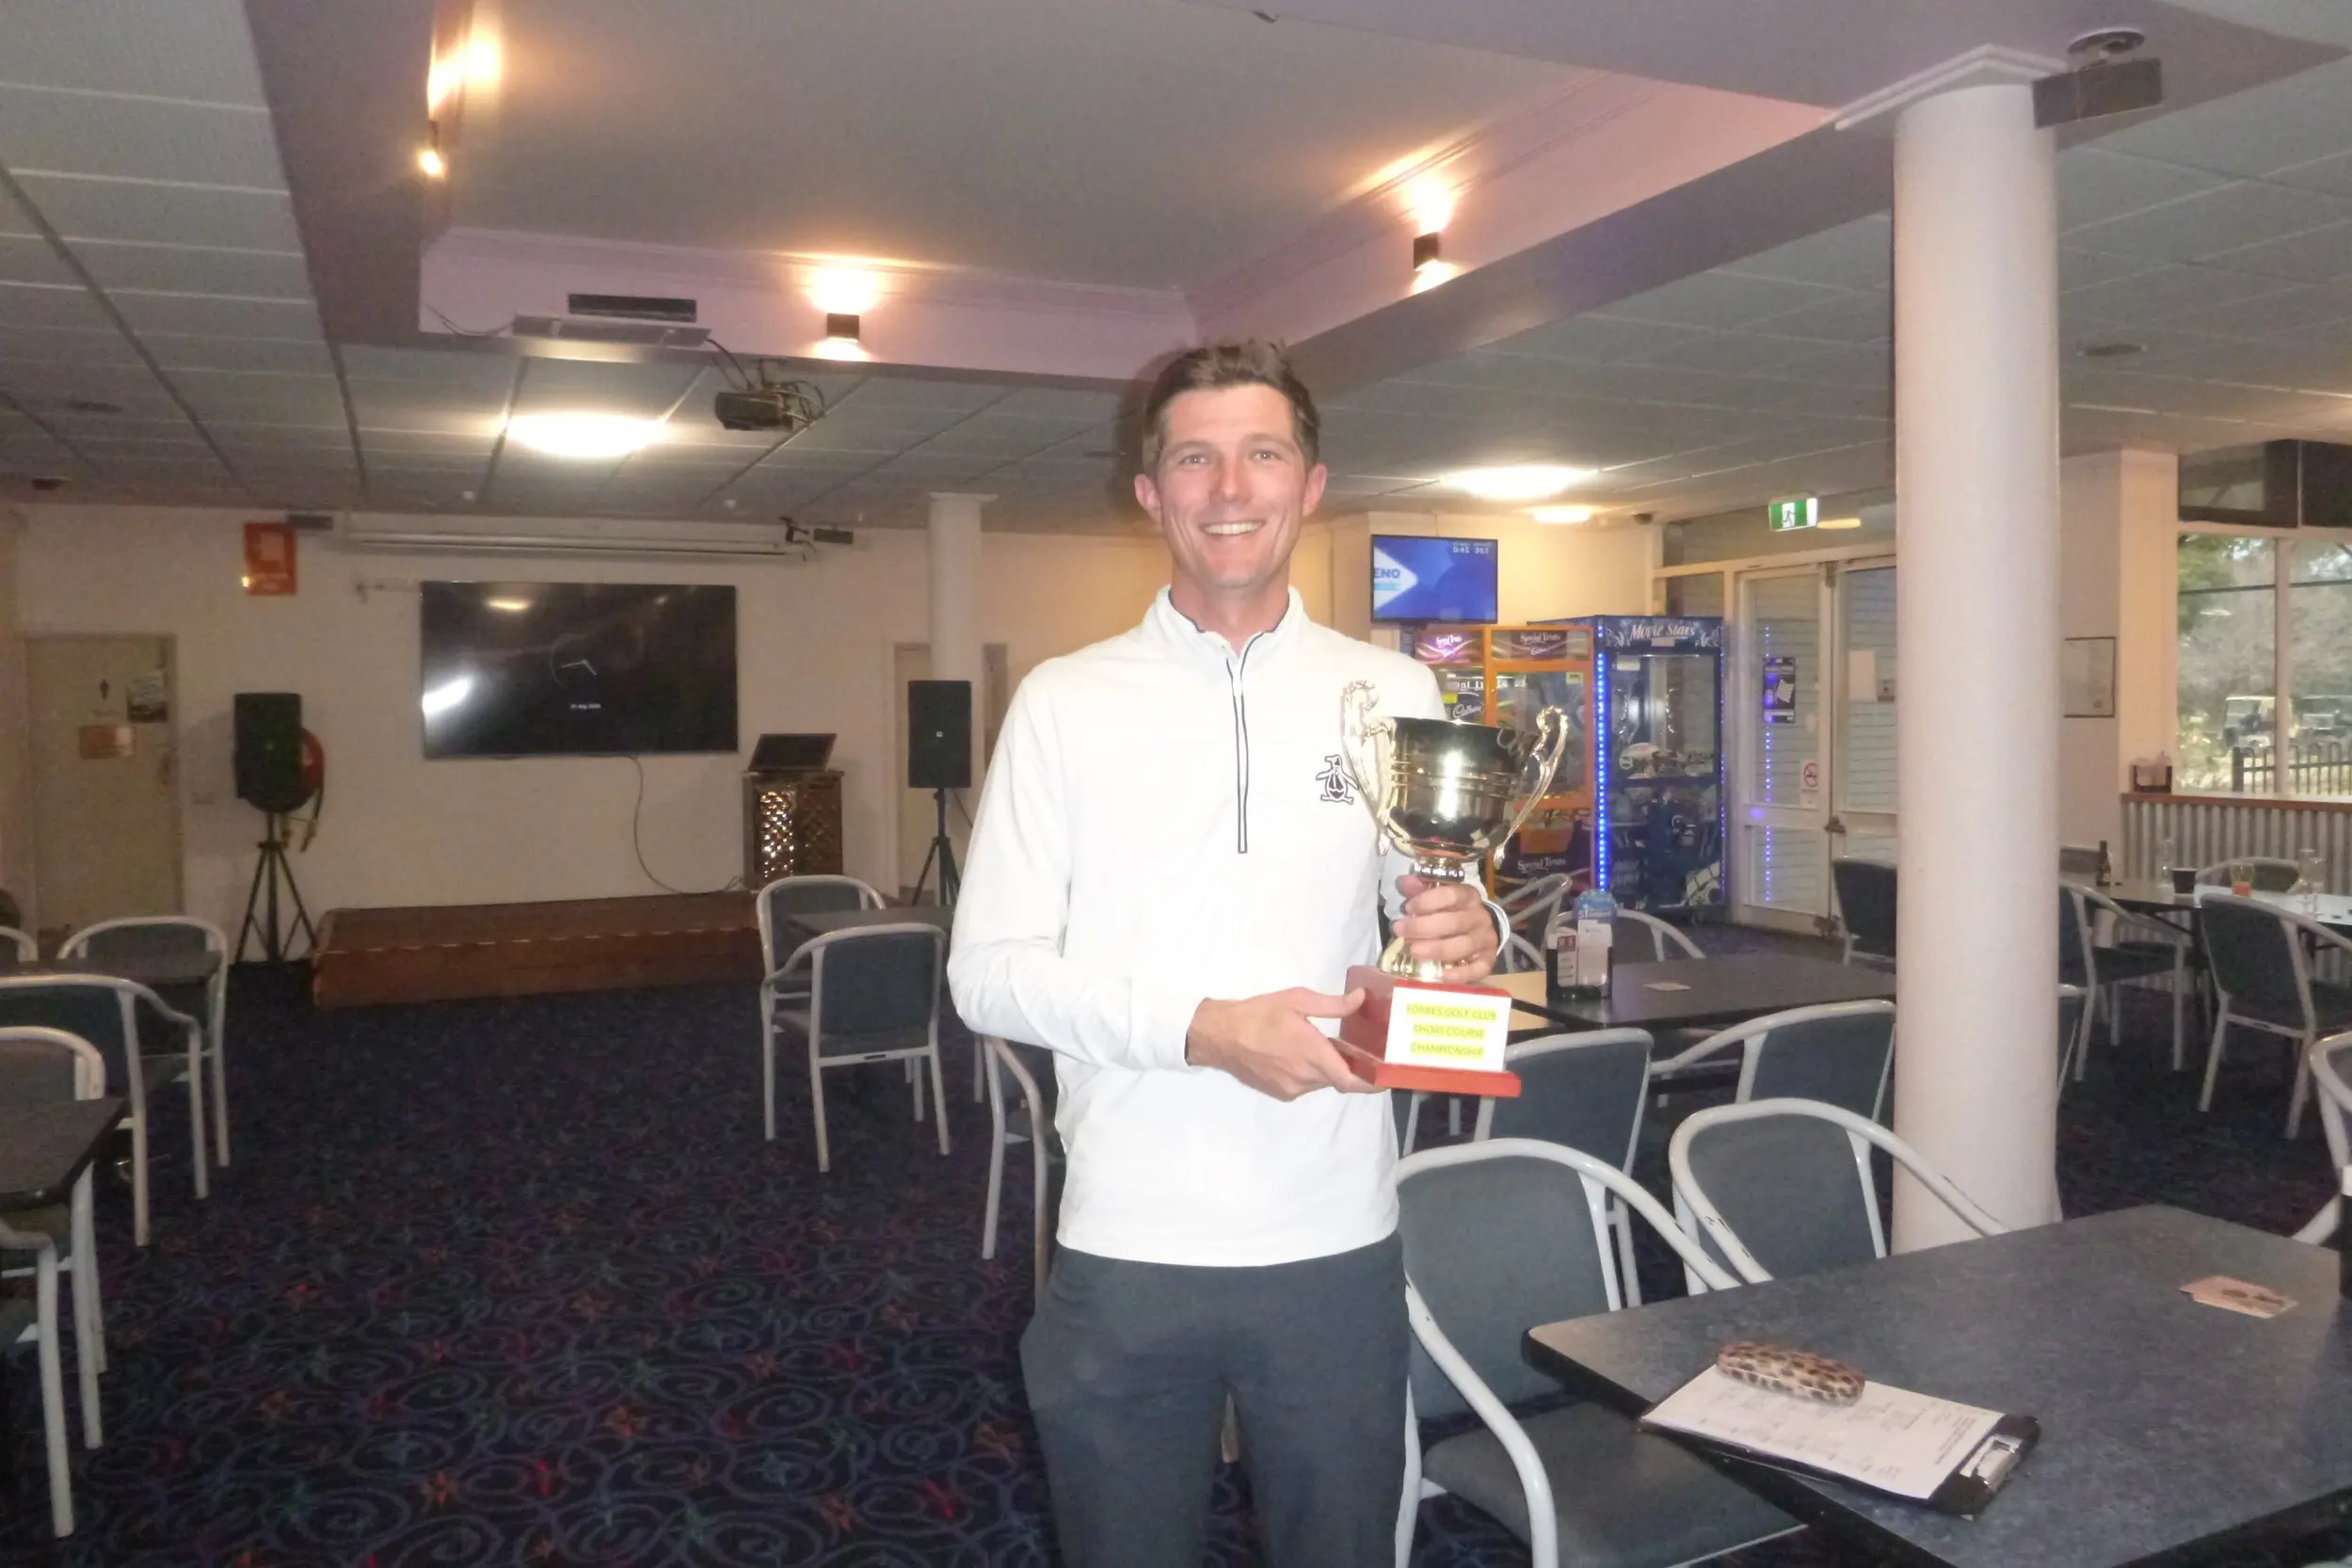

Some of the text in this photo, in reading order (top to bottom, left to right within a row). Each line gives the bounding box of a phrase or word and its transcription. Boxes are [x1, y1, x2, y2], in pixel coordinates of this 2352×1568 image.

[1630, 624, 1695, 640] Movie Stars
[1445, 1008, 1469, 1018] GOLF
[1472, 1011, 1497, 1021] CLUB
[1446, 1027, 1484, 1039] COURSE
[1410, 1042, 1484, 1055] CHAMPIONSHIP
